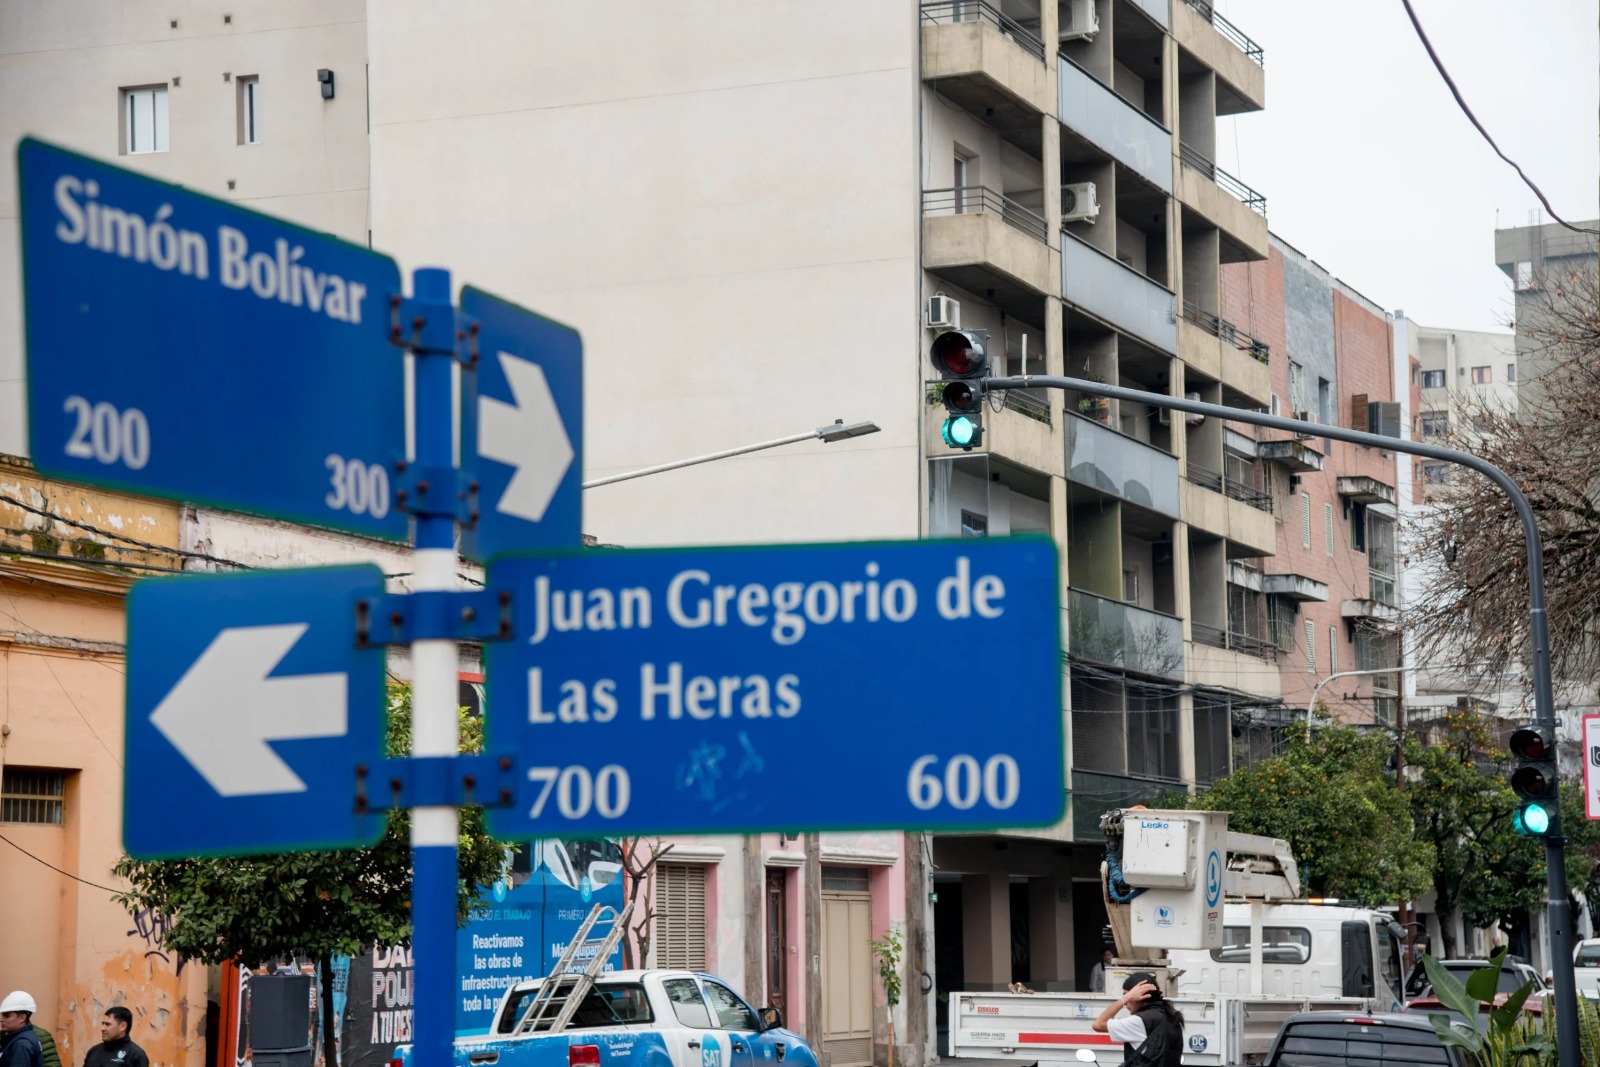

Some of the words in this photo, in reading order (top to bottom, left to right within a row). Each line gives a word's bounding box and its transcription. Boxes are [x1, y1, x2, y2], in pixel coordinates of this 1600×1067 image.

[54, 174, 209, 280] Simón
[218, 225, 367, 325] Bolívar
[63, 396, 151, 471] 200
[325, 454, 391, 520] 300
[529, 575, 652, 645] Juan
[666, 561, 918, 646] Gregorio
[936, 556, 1006, 620] de
[528, 667, 619, 724] Las
[641, 662, 802, 720] Heras
[528, 764, 632, 820] 700
[907, 753, 1021, 810] 600
[1141, 821, 1169, 829] Lesko
[503, 909, 531, 920] TRABAJO
[558, 909, 585, 920] PRIMERO
[473, 934, 524, 949] Reactivamos
[474, 953, 487, 970] las
[488, 953, 511, 969] obras
[513, 952, 522, 968] de
[463, 996, 481, 1012] toda
[484, 995, 492, 1010] la
[371, 1011, 379, 1044] A
[1192, 1037, 1204, 1046] DC
[703, 1049, 720, 1067] SAT
